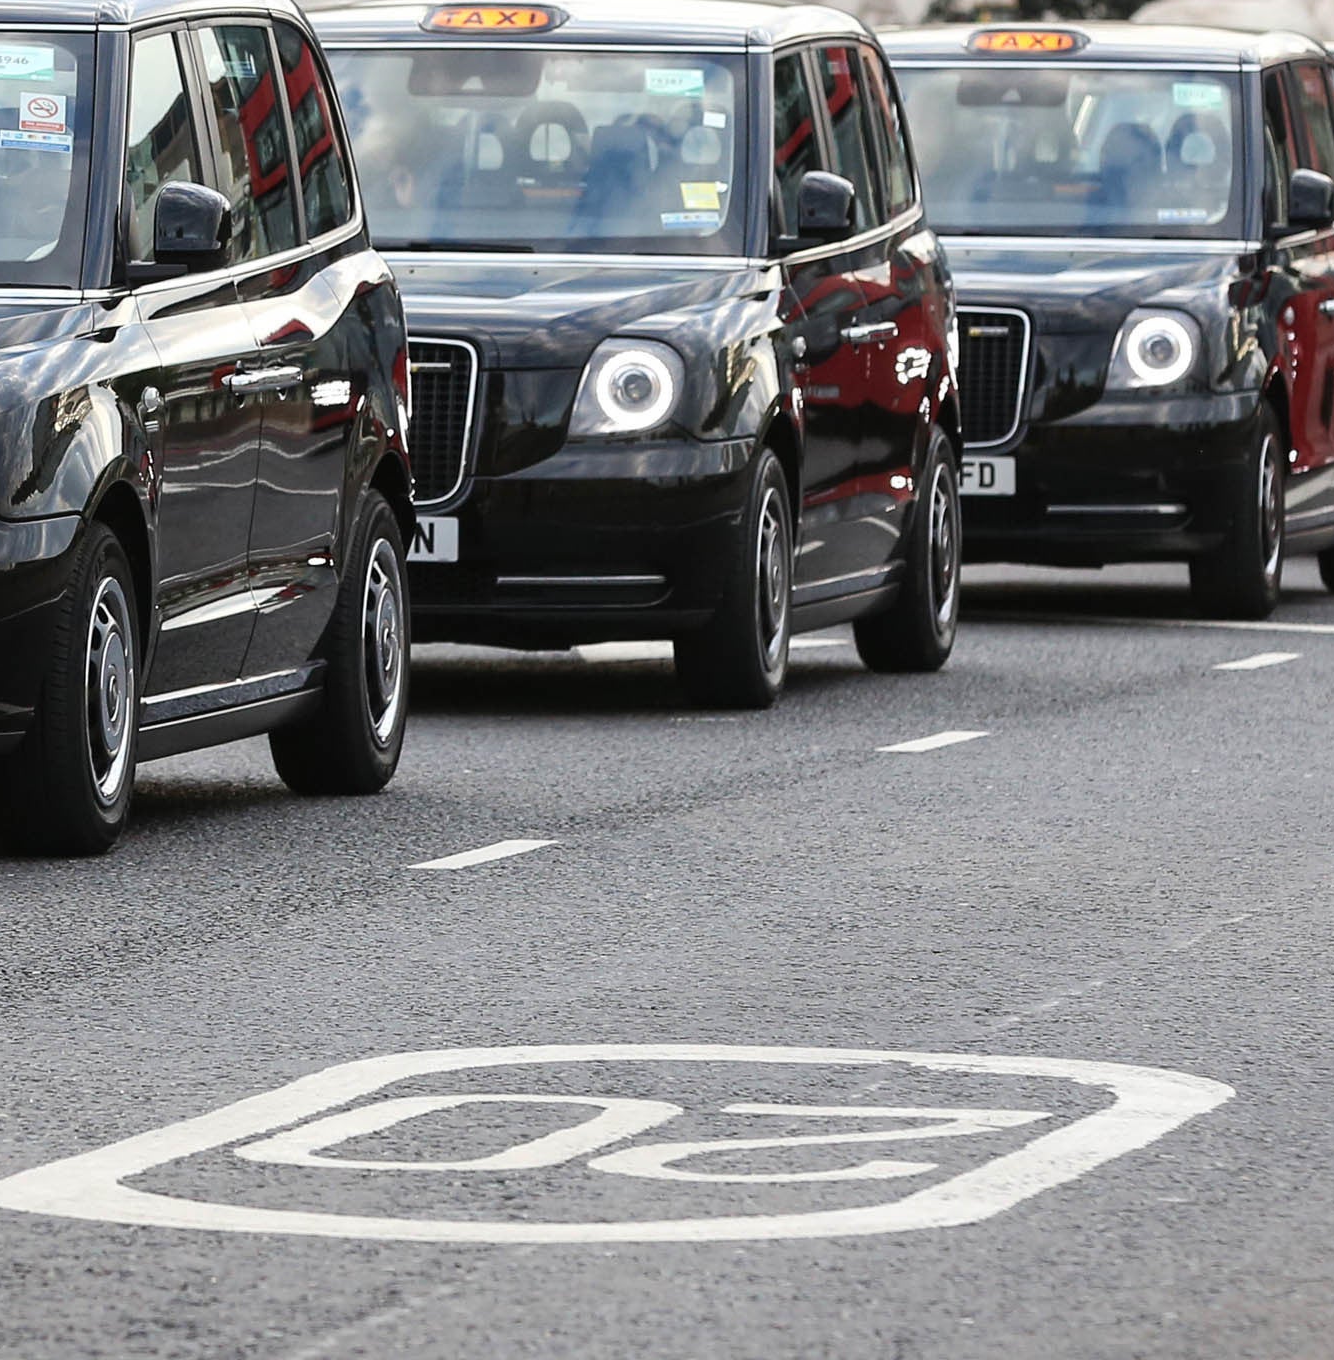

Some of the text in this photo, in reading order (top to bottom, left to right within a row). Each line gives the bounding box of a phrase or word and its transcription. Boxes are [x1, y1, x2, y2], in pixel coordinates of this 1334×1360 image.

[442, 10, 536, 25] TAXI
[979, 34, 1063, 49] TAXI
[959, 462, 995, 488] FD
